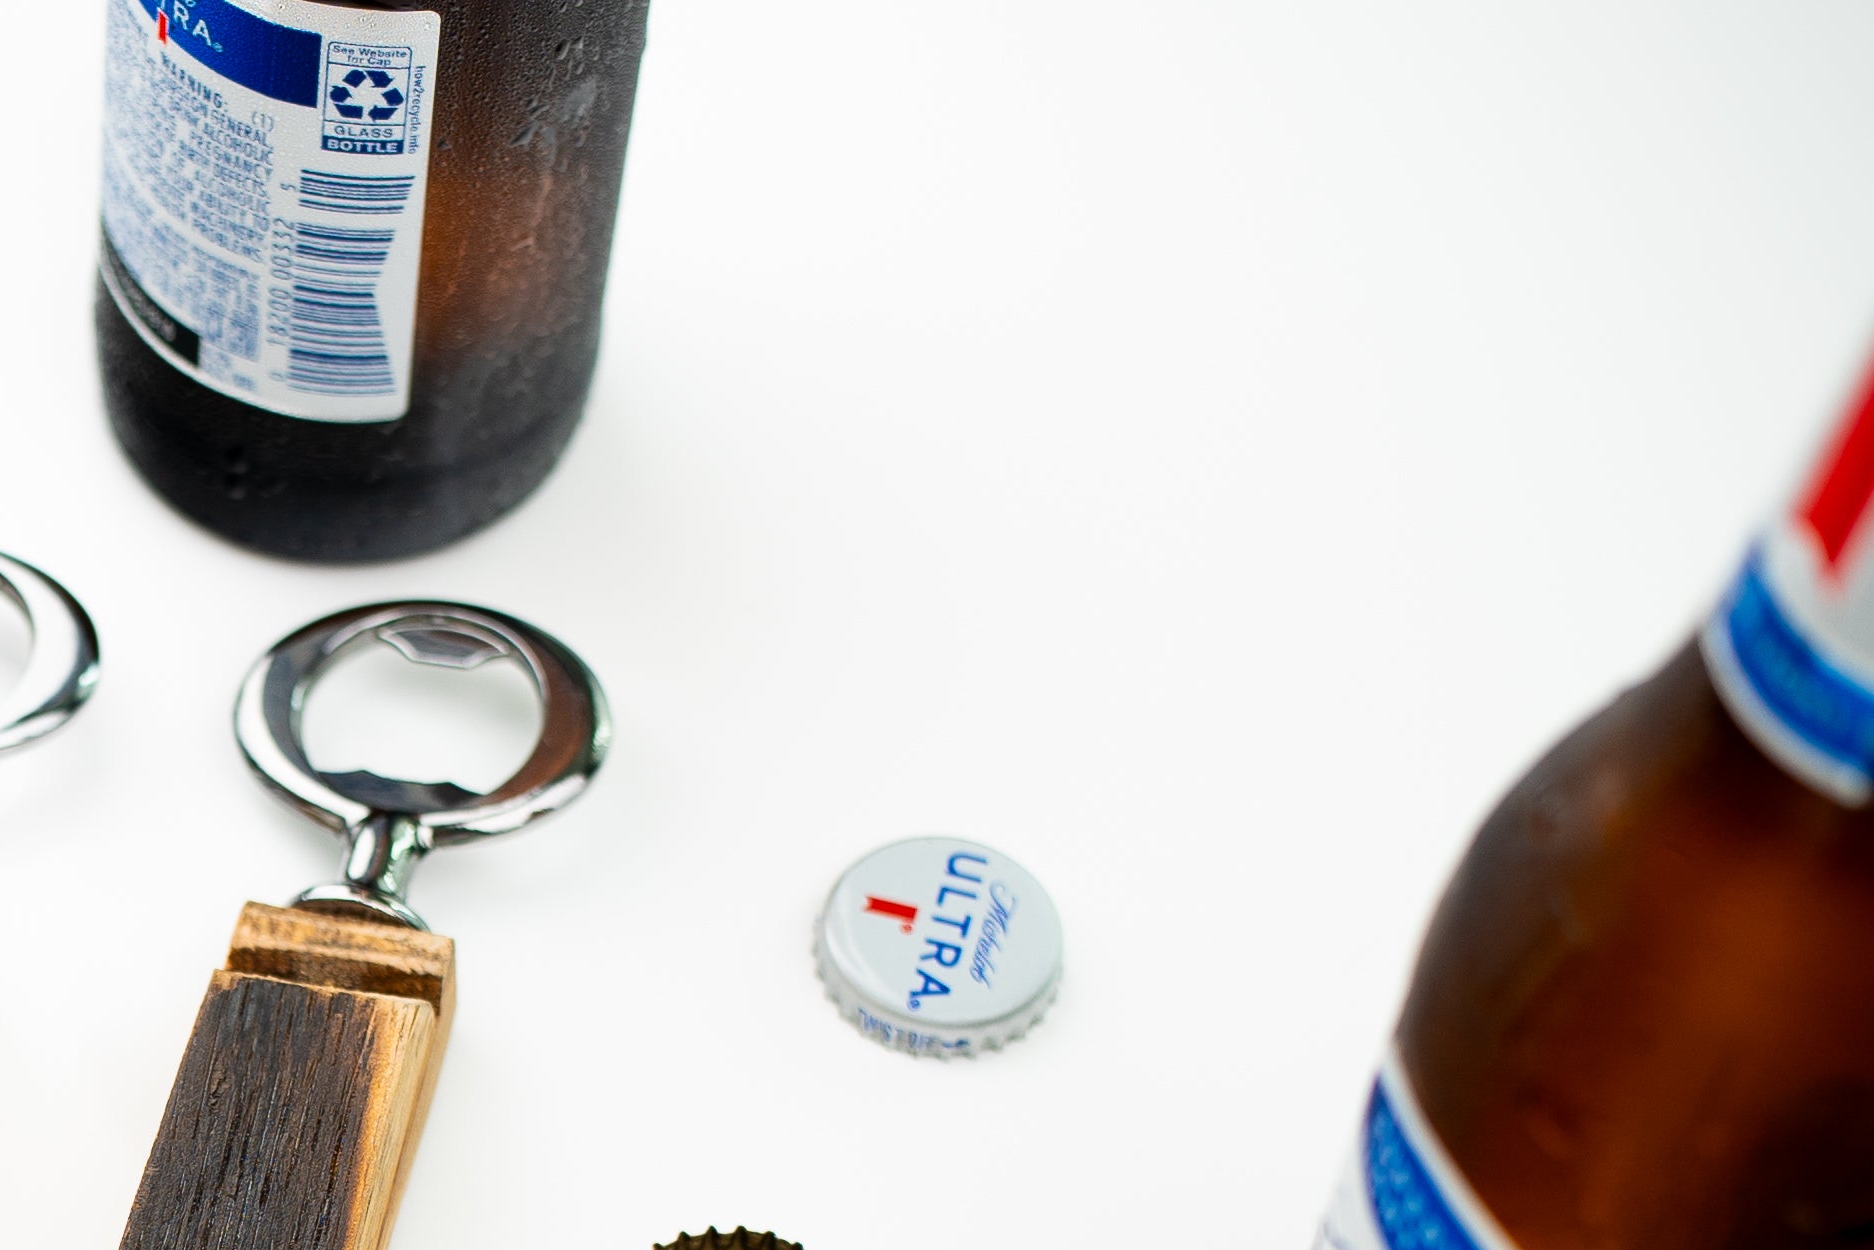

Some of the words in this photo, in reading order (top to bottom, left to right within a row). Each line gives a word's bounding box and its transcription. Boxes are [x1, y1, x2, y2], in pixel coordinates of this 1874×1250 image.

[332, 45, 355, 55] See
[359, 47, 407, 59] Website
[347, 55, 365, 64] for
[367, 56, 392, 67] Cap
[334, 125, 393, 138] GLASS
[327, 138, 398, 153] BOTTLE
[270, 218, 296, 281] 00332
[909, 852, 988, 998] ULTRA
